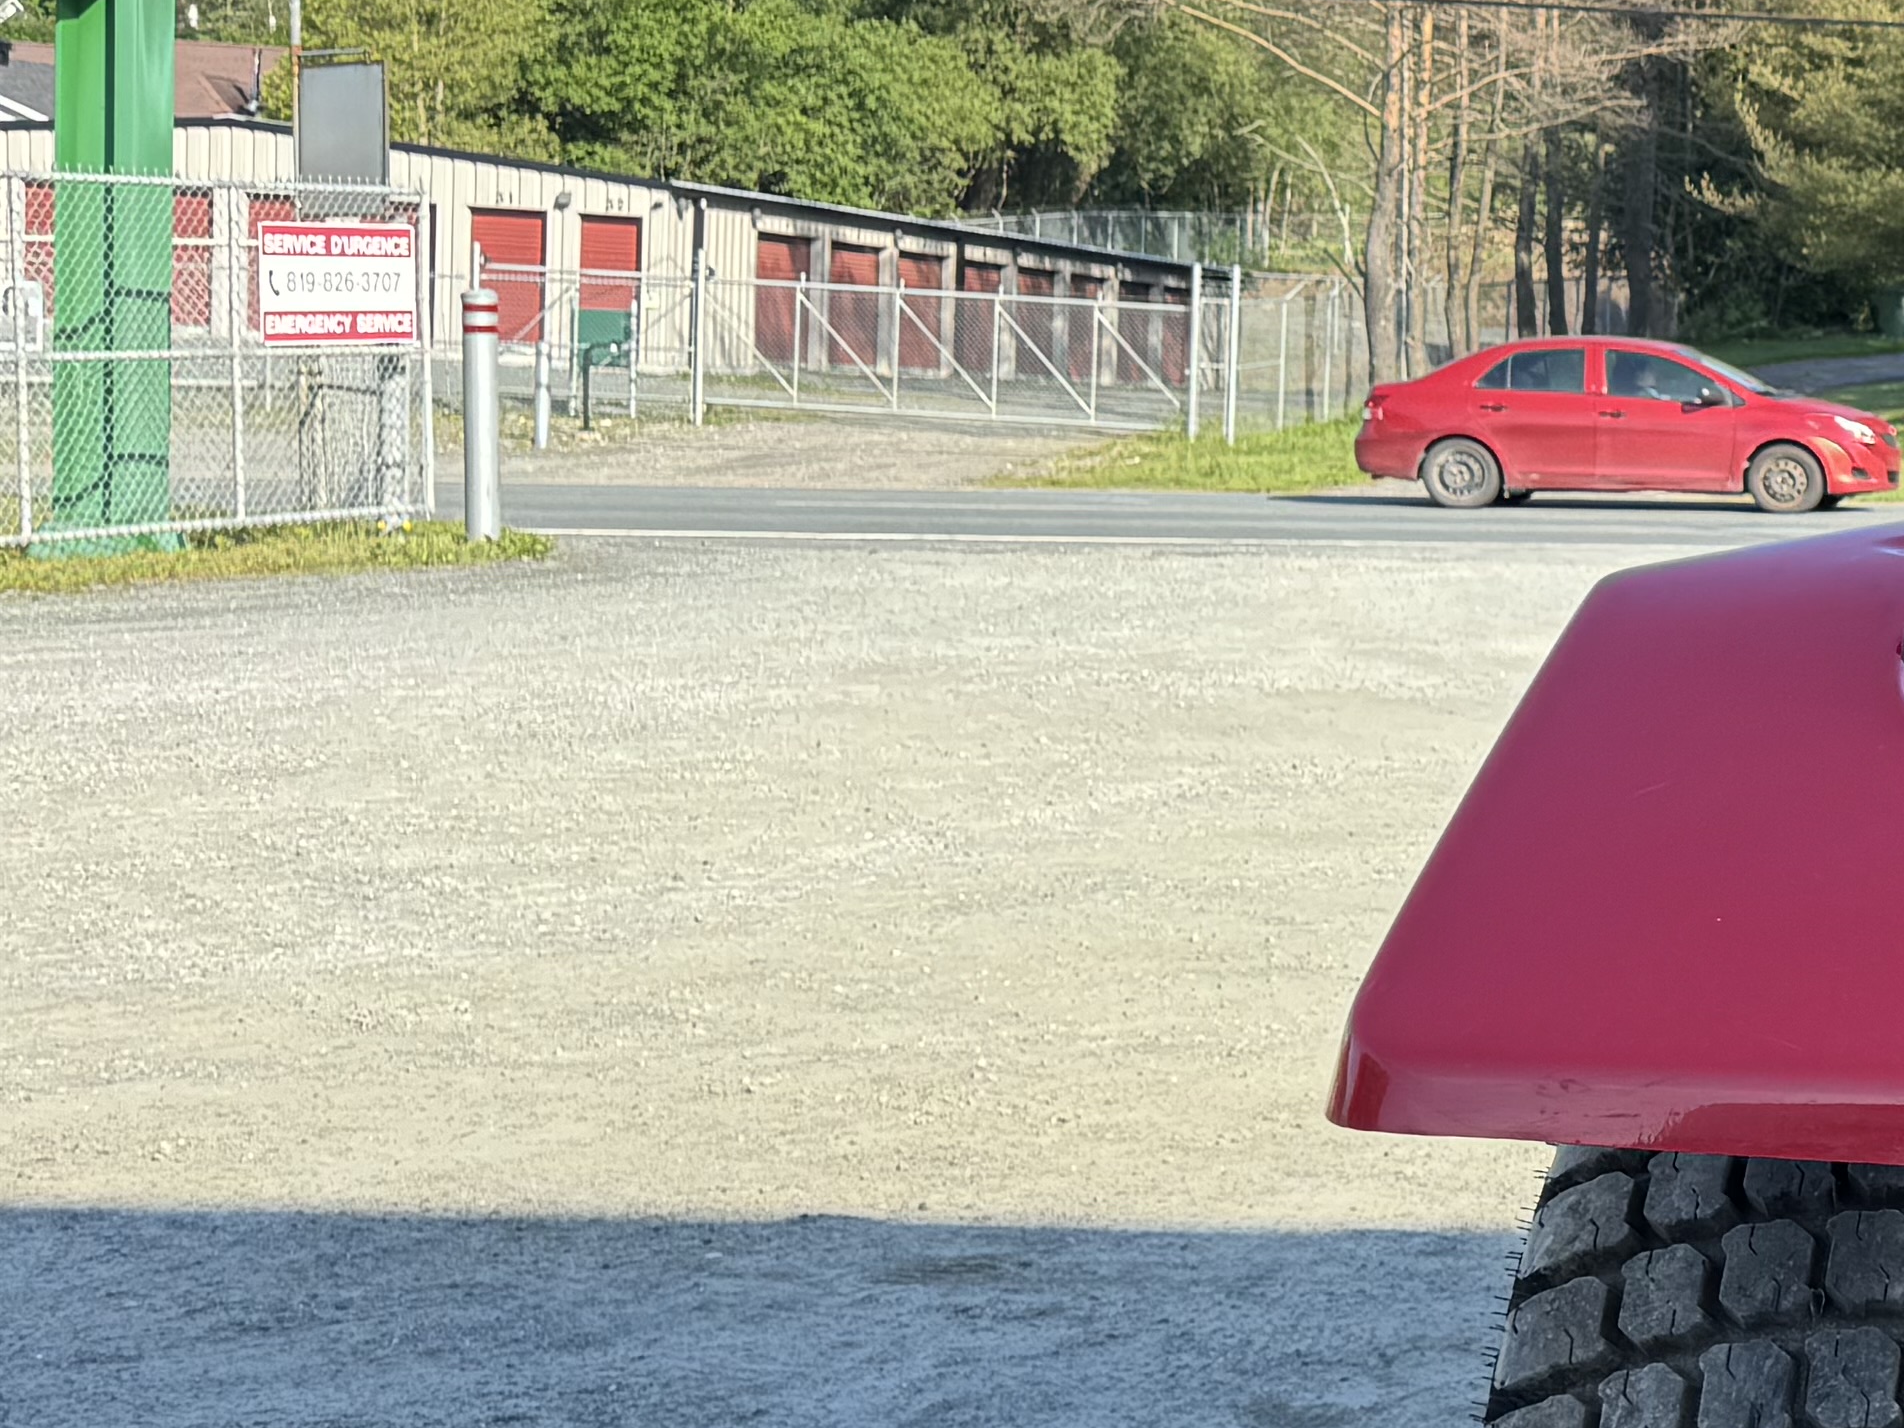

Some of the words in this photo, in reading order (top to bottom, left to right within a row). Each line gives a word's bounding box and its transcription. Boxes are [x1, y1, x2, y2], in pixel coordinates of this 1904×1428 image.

[263, 232, 327, 255] SERVICE
[330, 234, 410, 256] D'URGENCE
[286, 271, 401, 292] 819-826-3707
[265, 314, 352, 335] EMERGENCY
[356, 313, 413, 333] SERVICE
